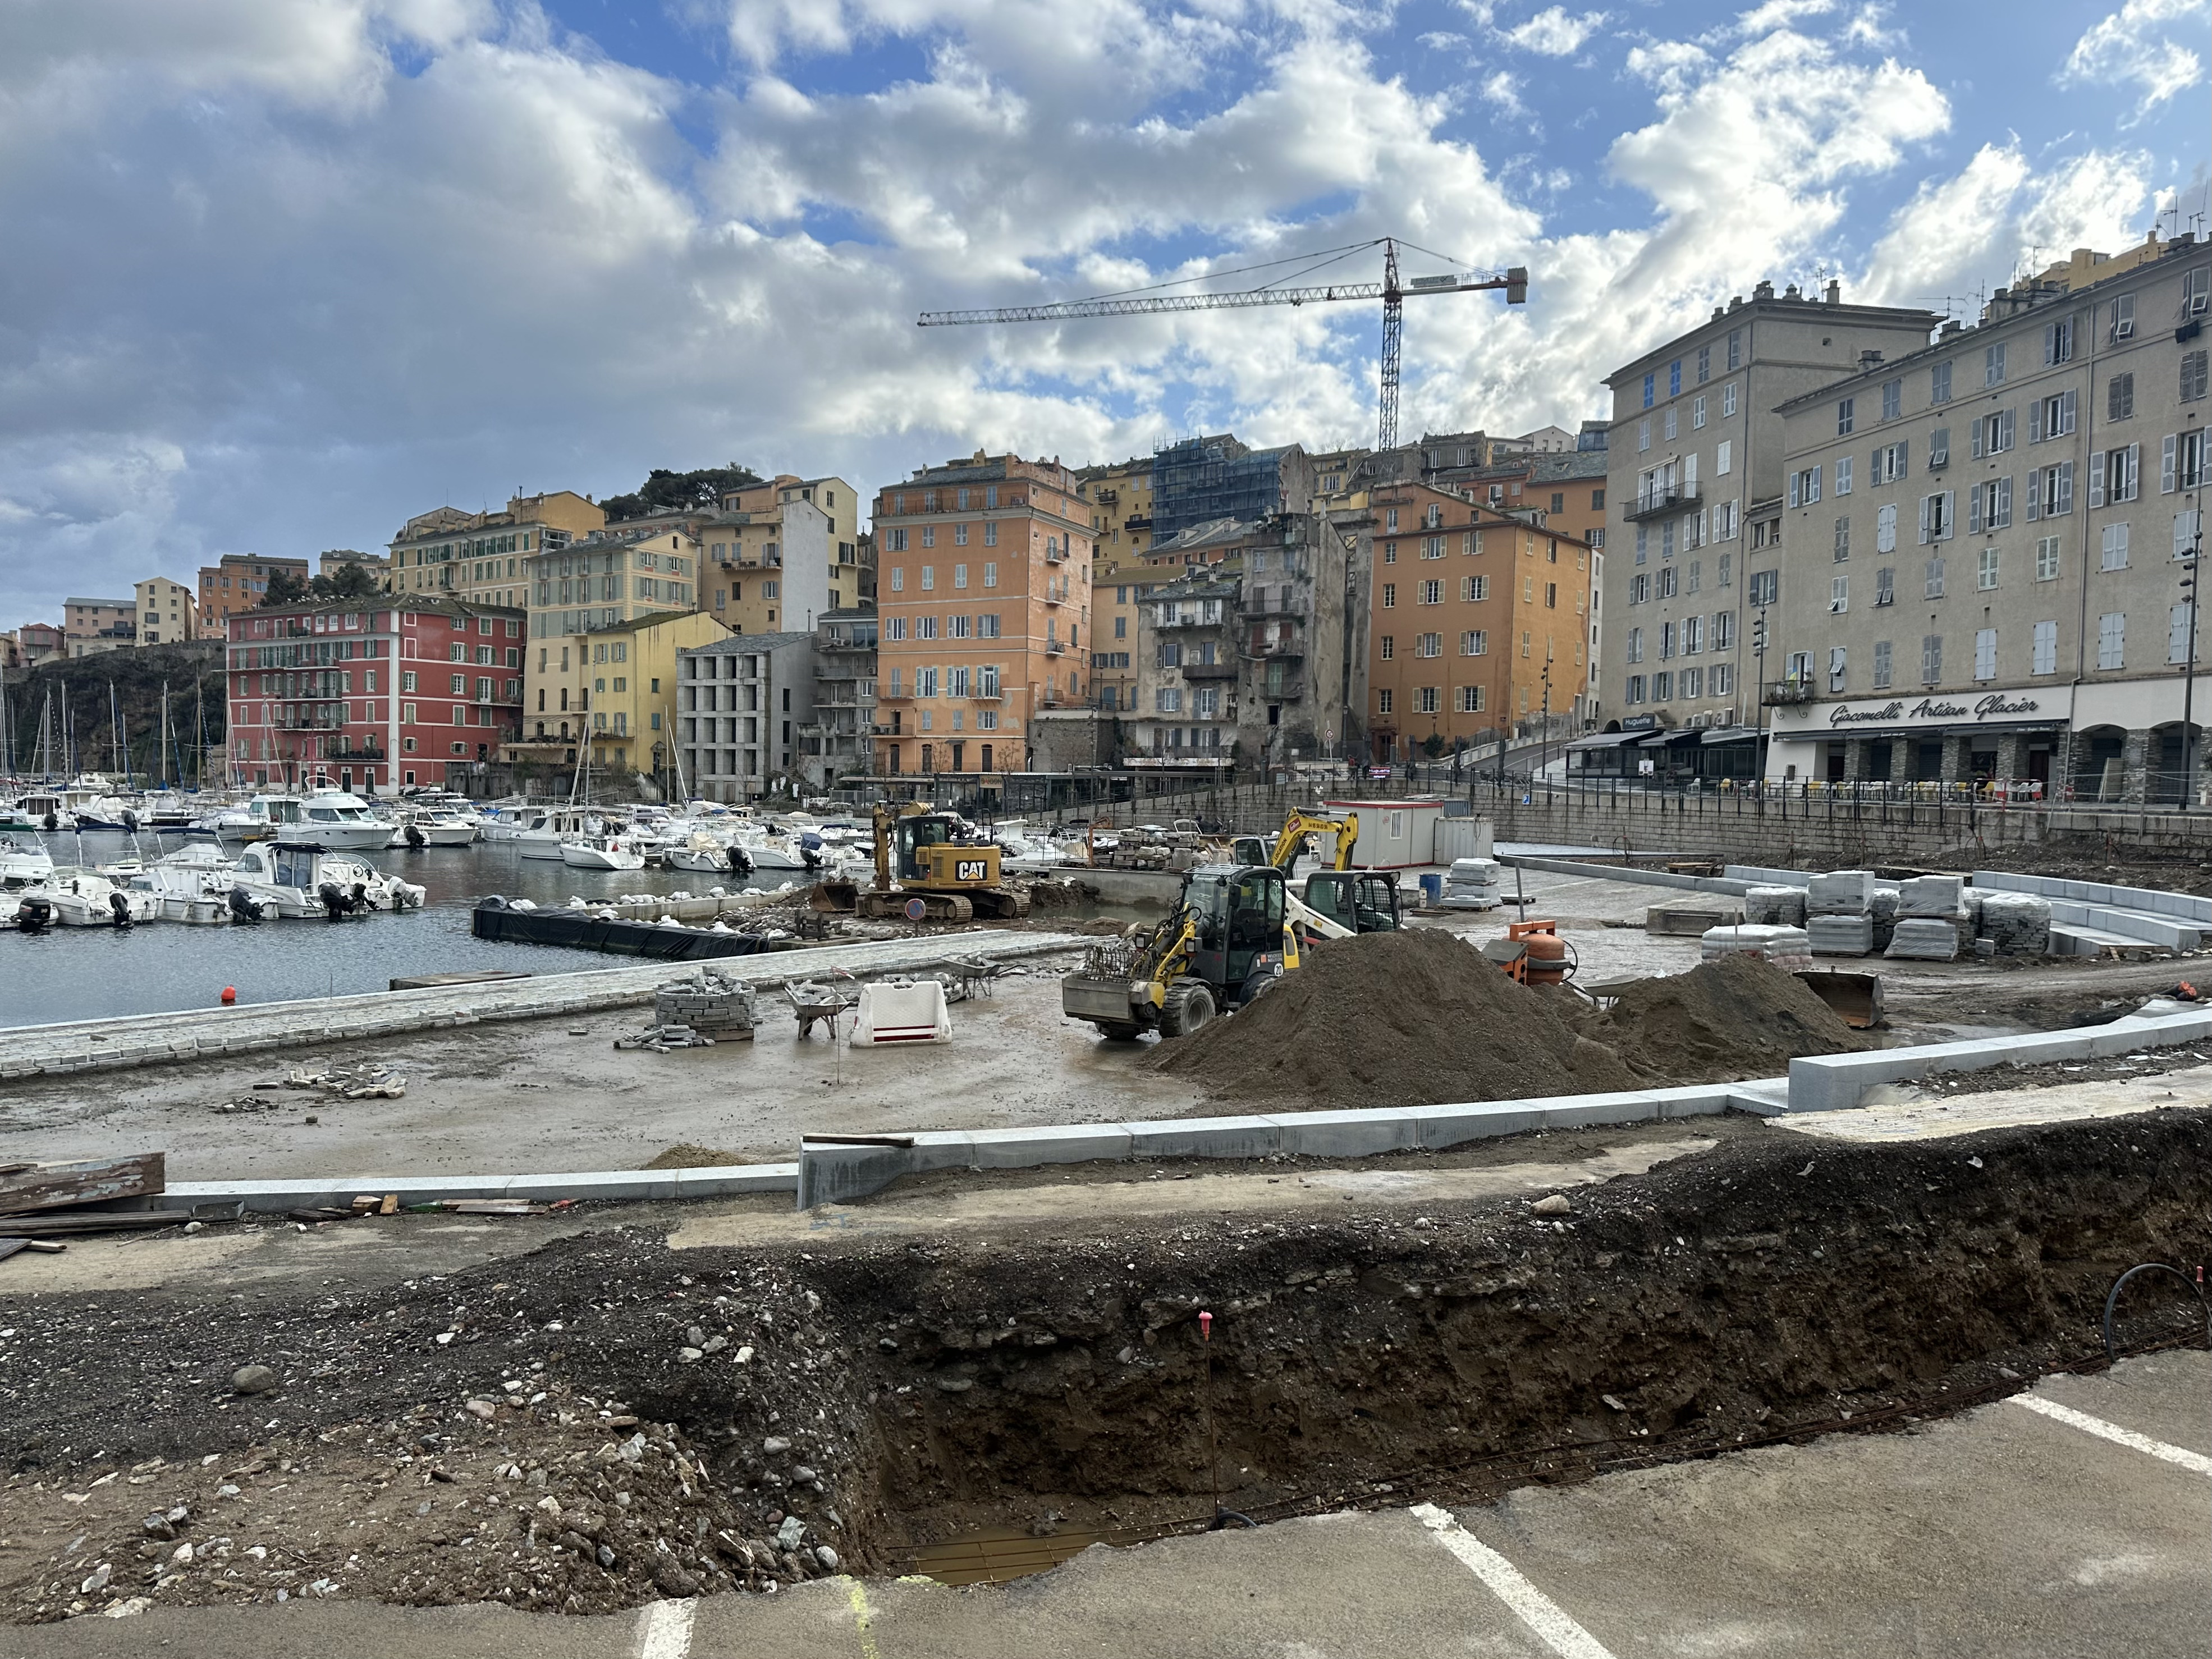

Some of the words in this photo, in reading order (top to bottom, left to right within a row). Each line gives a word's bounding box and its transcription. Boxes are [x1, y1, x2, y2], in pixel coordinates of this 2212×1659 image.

[1829, 702, 1903, 728] Giacomelli
[1908, 698, 1967, 718] Artisan
[1974, 694, 2039, 721] Glacier
[1625, 717, 1651, 726] Huguette
[1274, 837, 1288, 860] LOCATION
[959, 861, 985, 880] CAT
[1276, 965, 1281, 975] 20
